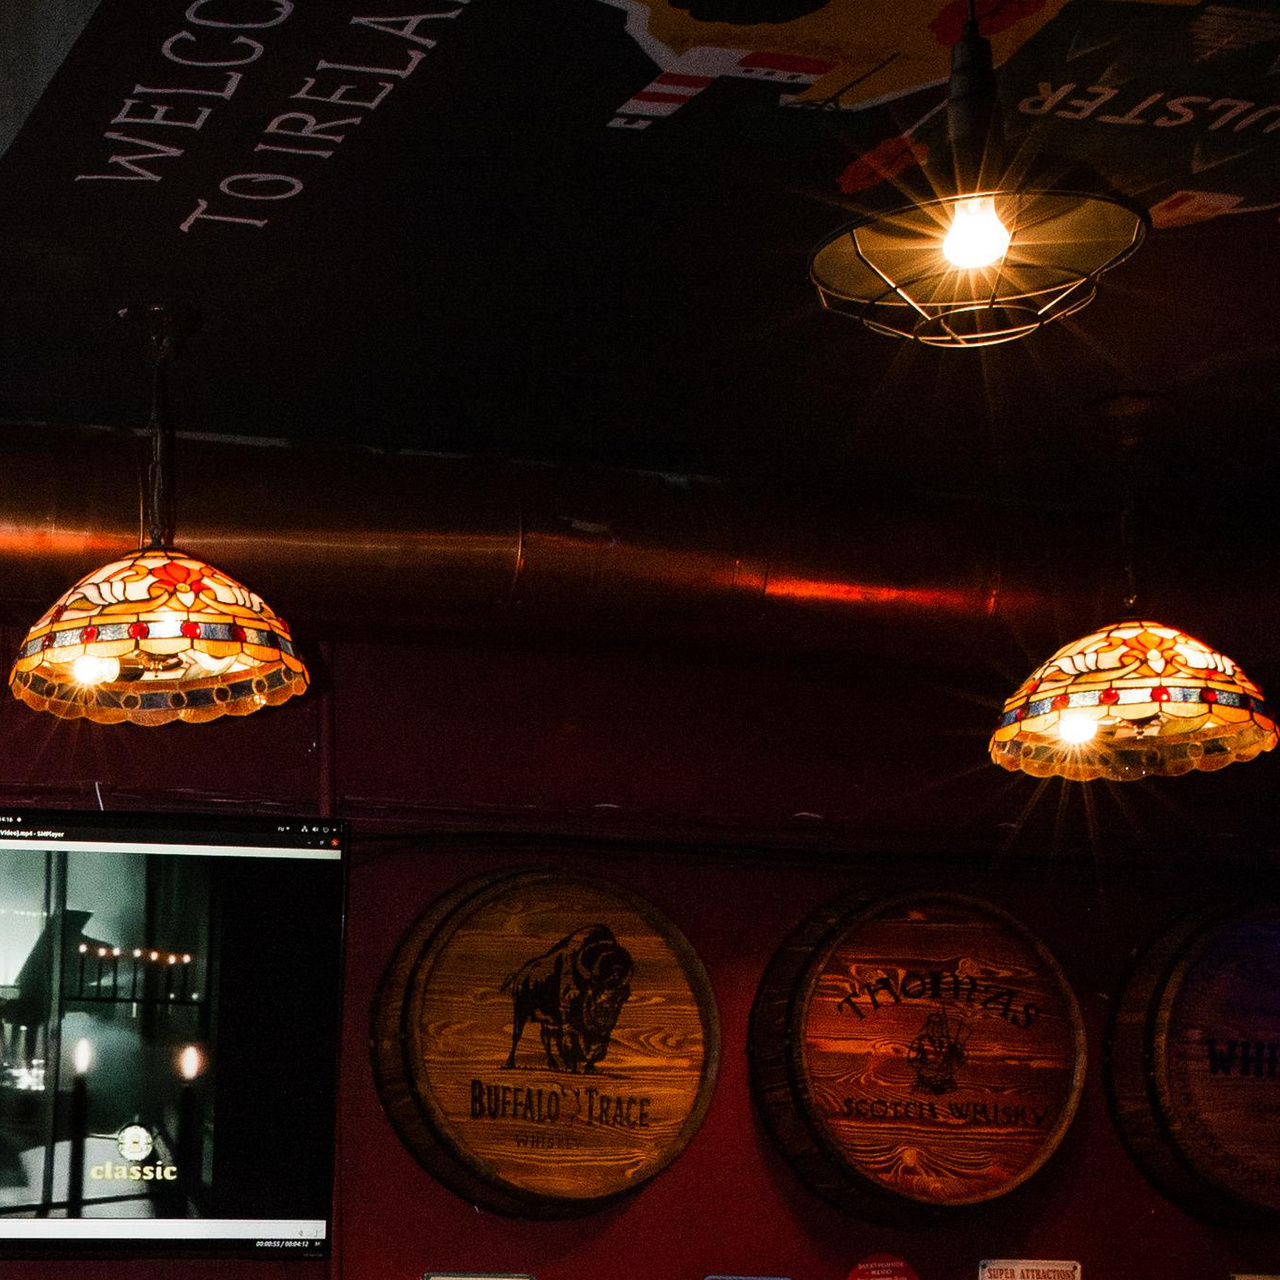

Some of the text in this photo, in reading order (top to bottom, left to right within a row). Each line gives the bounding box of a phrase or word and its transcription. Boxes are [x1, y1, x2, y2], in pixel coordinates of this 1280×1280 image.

[179, 0, 472, 233] TO IRELA
[1017, 81, 1280, 134] ULSTER
[471, 1079, 652, 1128] BUFFALO TRACE
[844, 1098, 939, 1120] SCOTCH
[90, 1160, 178, 1181] classic
[988, 1268, 1076, 1280] SUPER ATTRACTIONS
